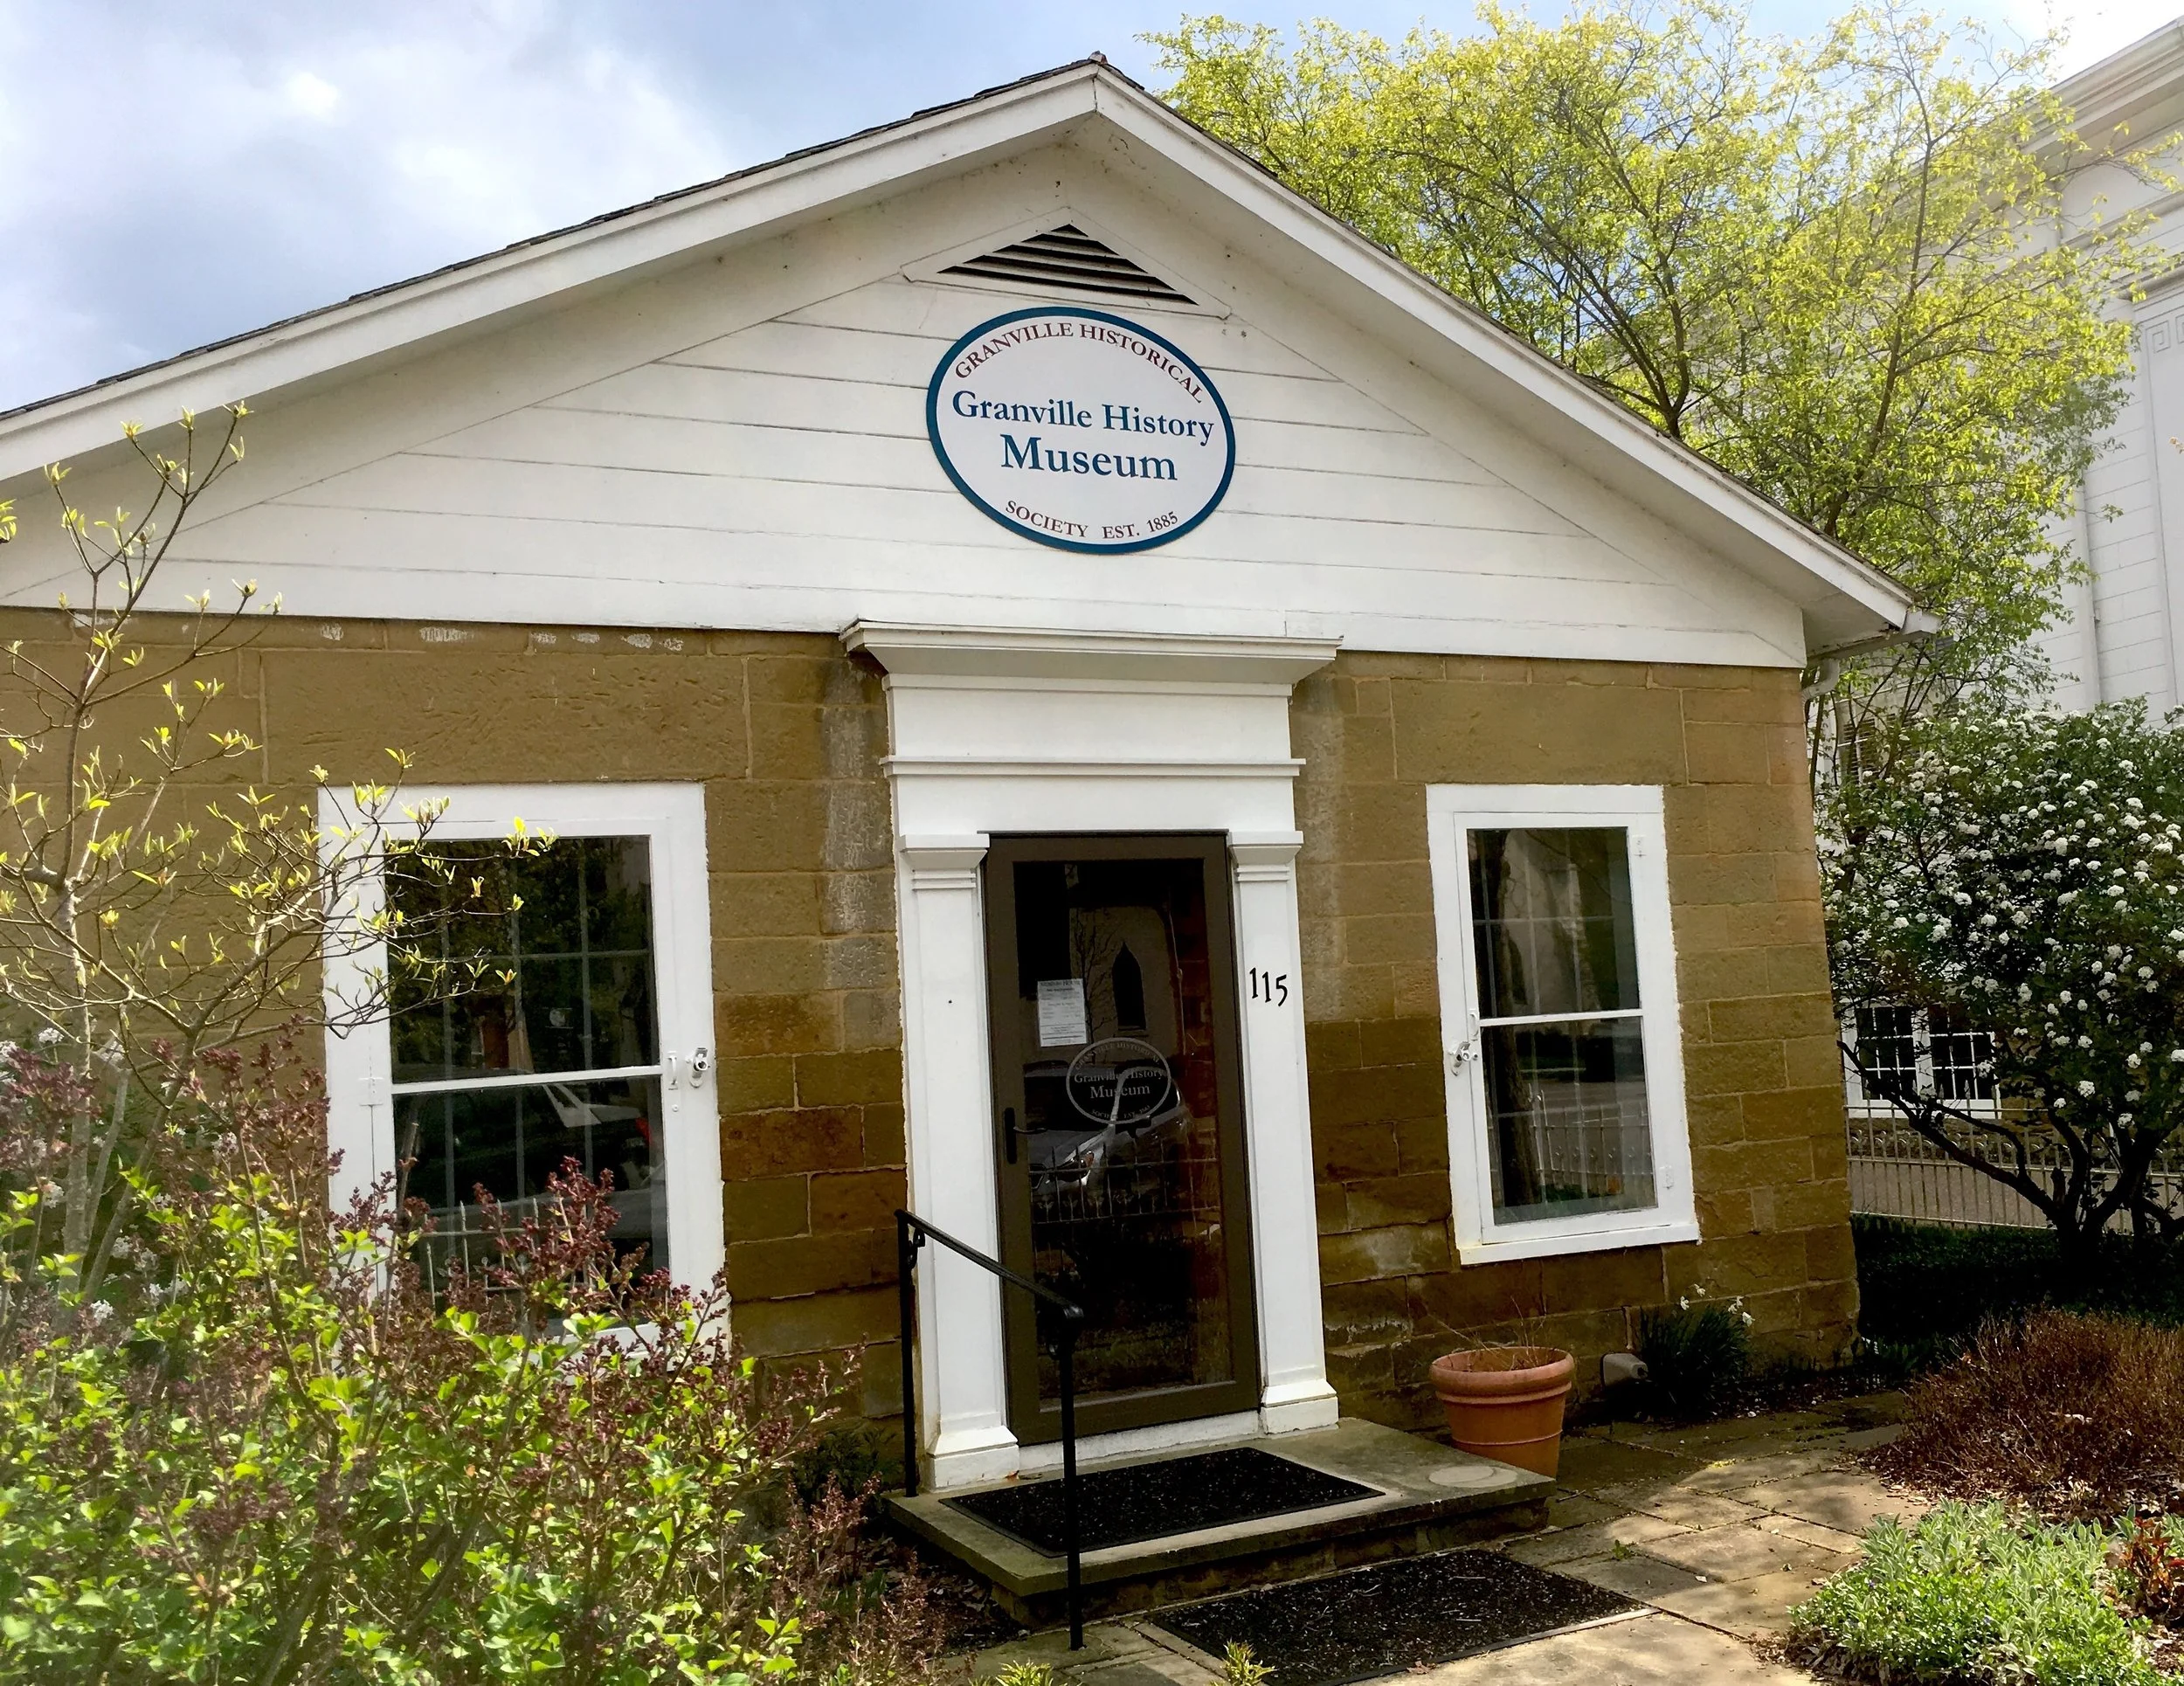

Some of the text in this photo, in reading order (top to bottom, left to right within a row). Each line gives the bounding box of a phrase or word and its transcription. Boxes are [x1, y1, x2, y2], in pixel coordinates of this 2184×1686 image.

[955, 322, 1203, 404] GRANVILLE HISTORICAL
[952, 390, 1214, 446] Granville History
[1000, 434, 1178, 481] Museum
[1006, 501, 1178, 539] SOCIETY EST. 1885
[1249, 967, 1288, 1006] 115
[1090, 1085, 1151, 1099] Mueum
